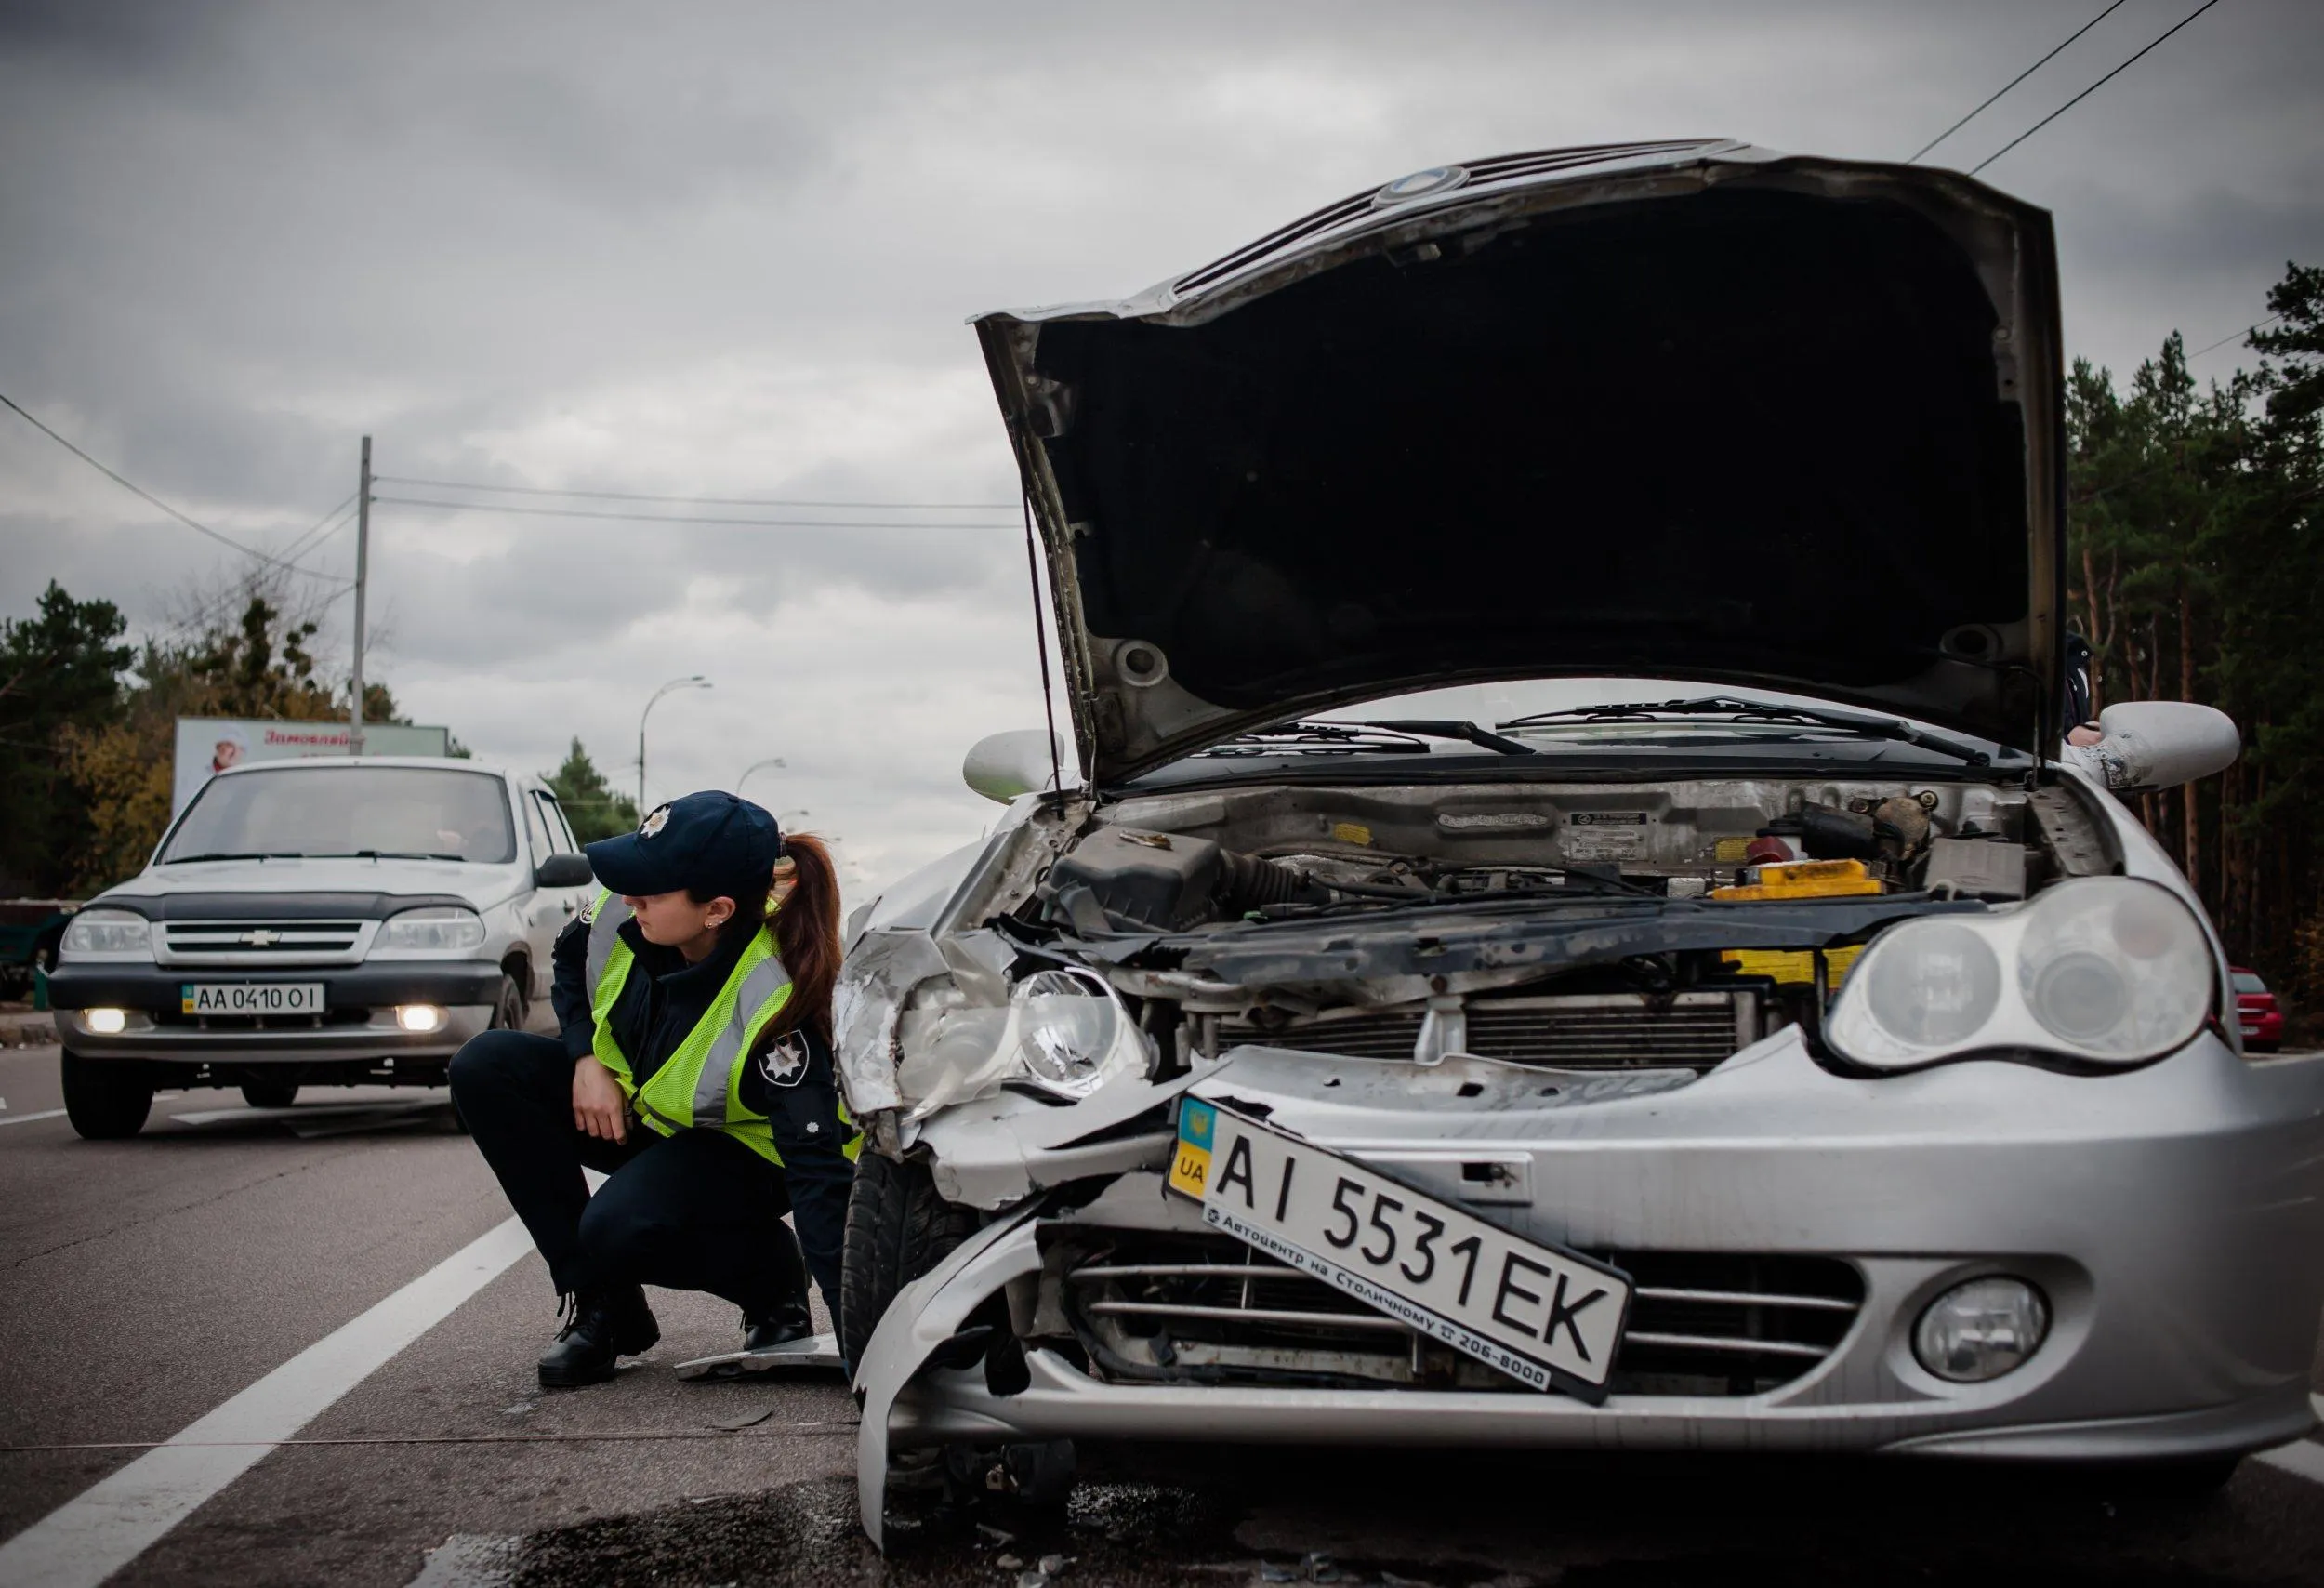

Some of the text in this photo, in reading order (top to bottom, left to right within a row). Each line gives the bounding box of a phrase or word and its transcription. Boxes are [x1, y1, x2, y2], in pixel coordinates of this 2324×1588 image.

[198, 988, 227, 1009] AA
[233, 988, 282, 1009] 0410
[1180, 1157, 1204, 1184] UA
[1216, 1134, 1609, 1363] AI 5531 EK
[1222, 1215, 1544, 1385] Автоцентр на Столичному 206-8000
